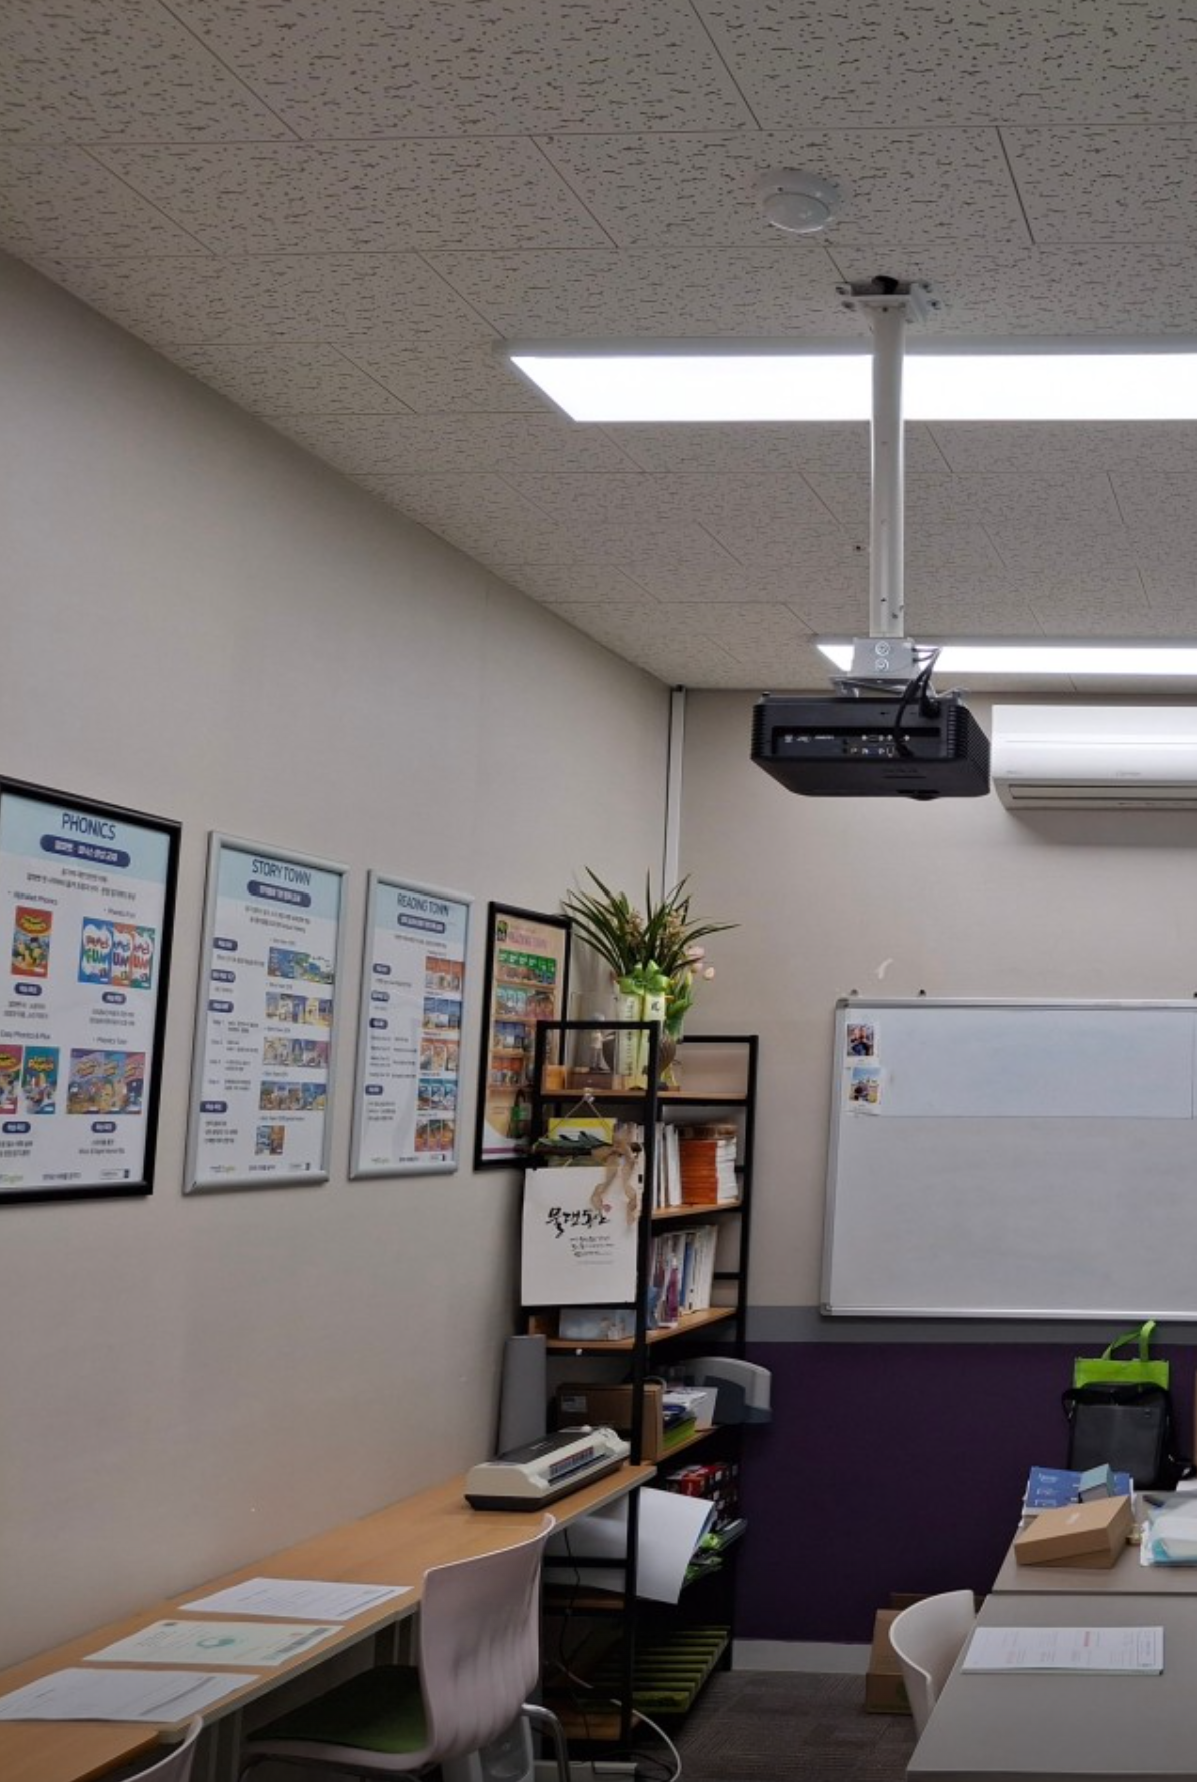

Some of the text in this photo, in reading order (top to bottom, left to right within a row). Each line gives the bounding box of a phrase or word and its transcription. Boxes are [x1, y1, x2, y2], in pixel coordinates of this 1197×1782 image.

[61, 812, 117, 841] PHONICS
[252, 858, 312, 887] STORY TOWN
[397, 892, 428, 913] READING
